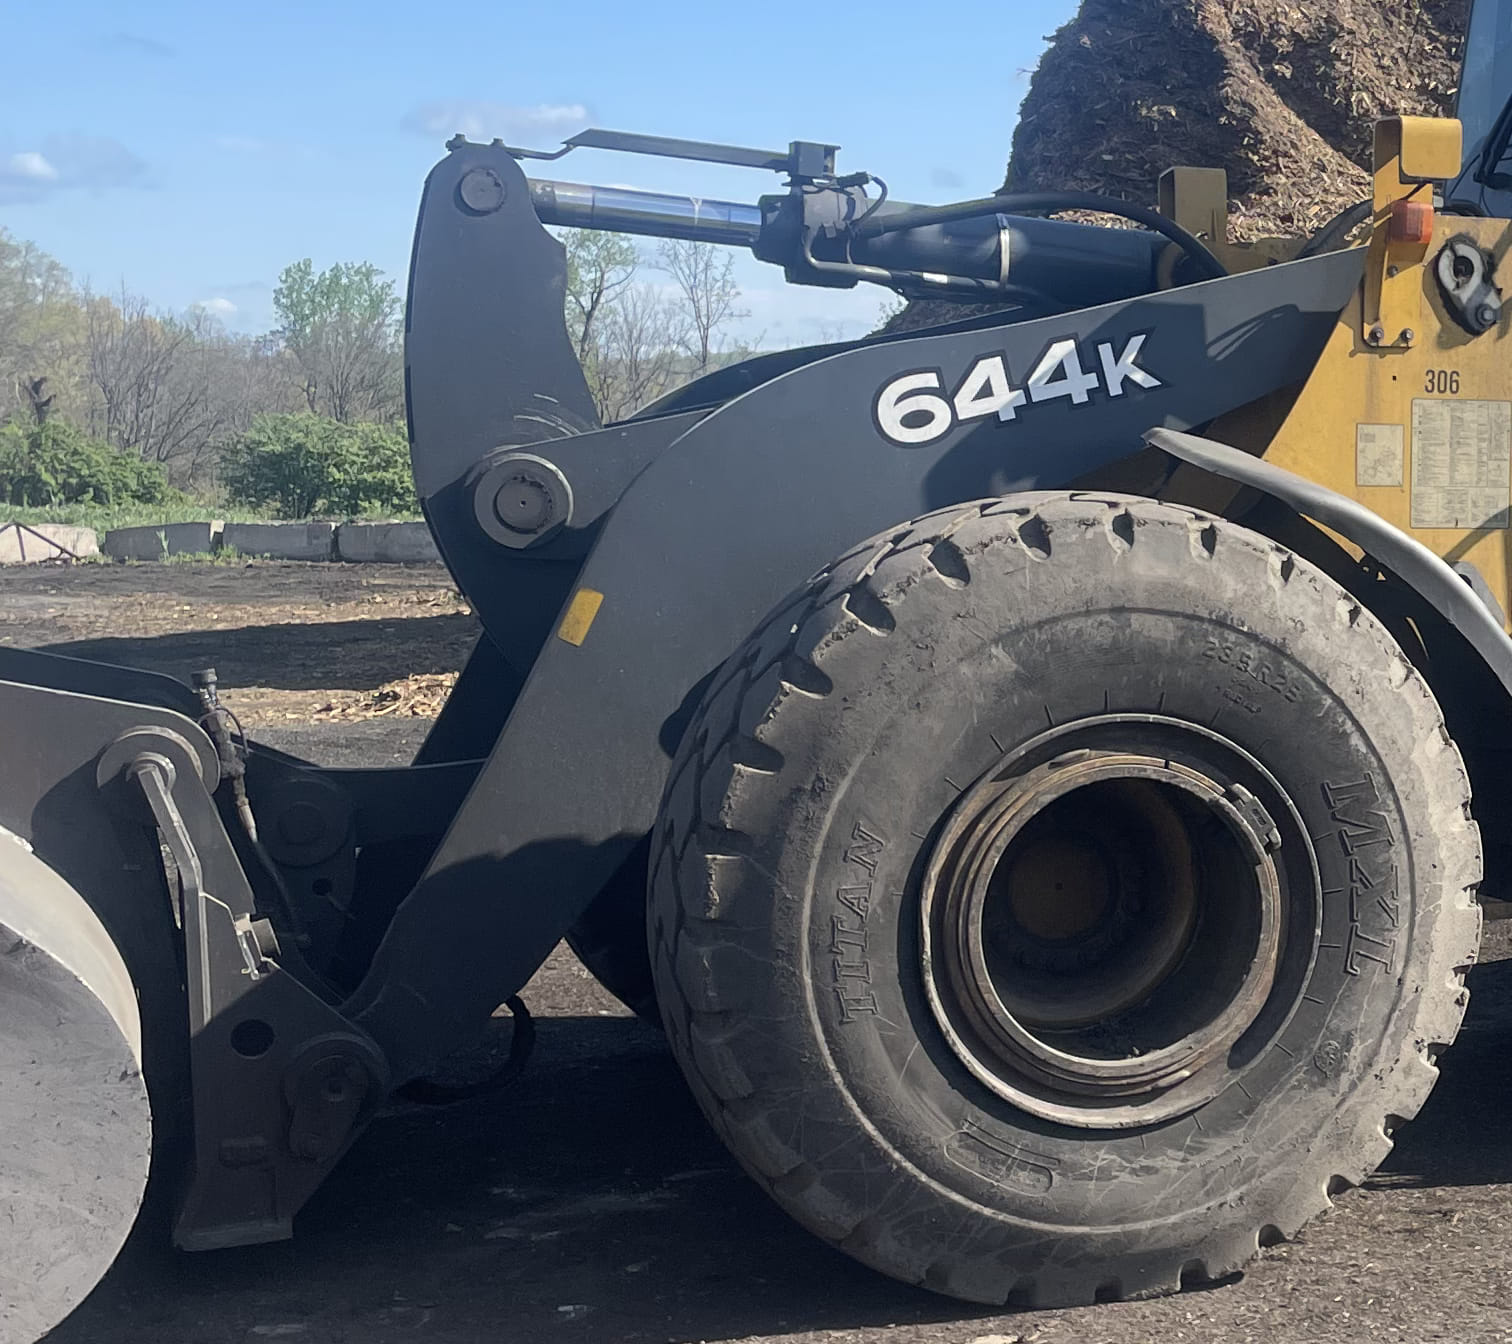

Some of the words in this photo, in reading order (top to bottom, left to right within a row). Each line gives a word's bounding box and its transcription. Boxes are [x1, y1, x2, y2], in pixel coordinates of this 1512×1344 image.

[877, 334, 1162, 443] 644K
[1424, 369, 1460, 394] 306
[829, 821, 885, 1024] TITAN
[1320, 771, 1399, 975] MXL
